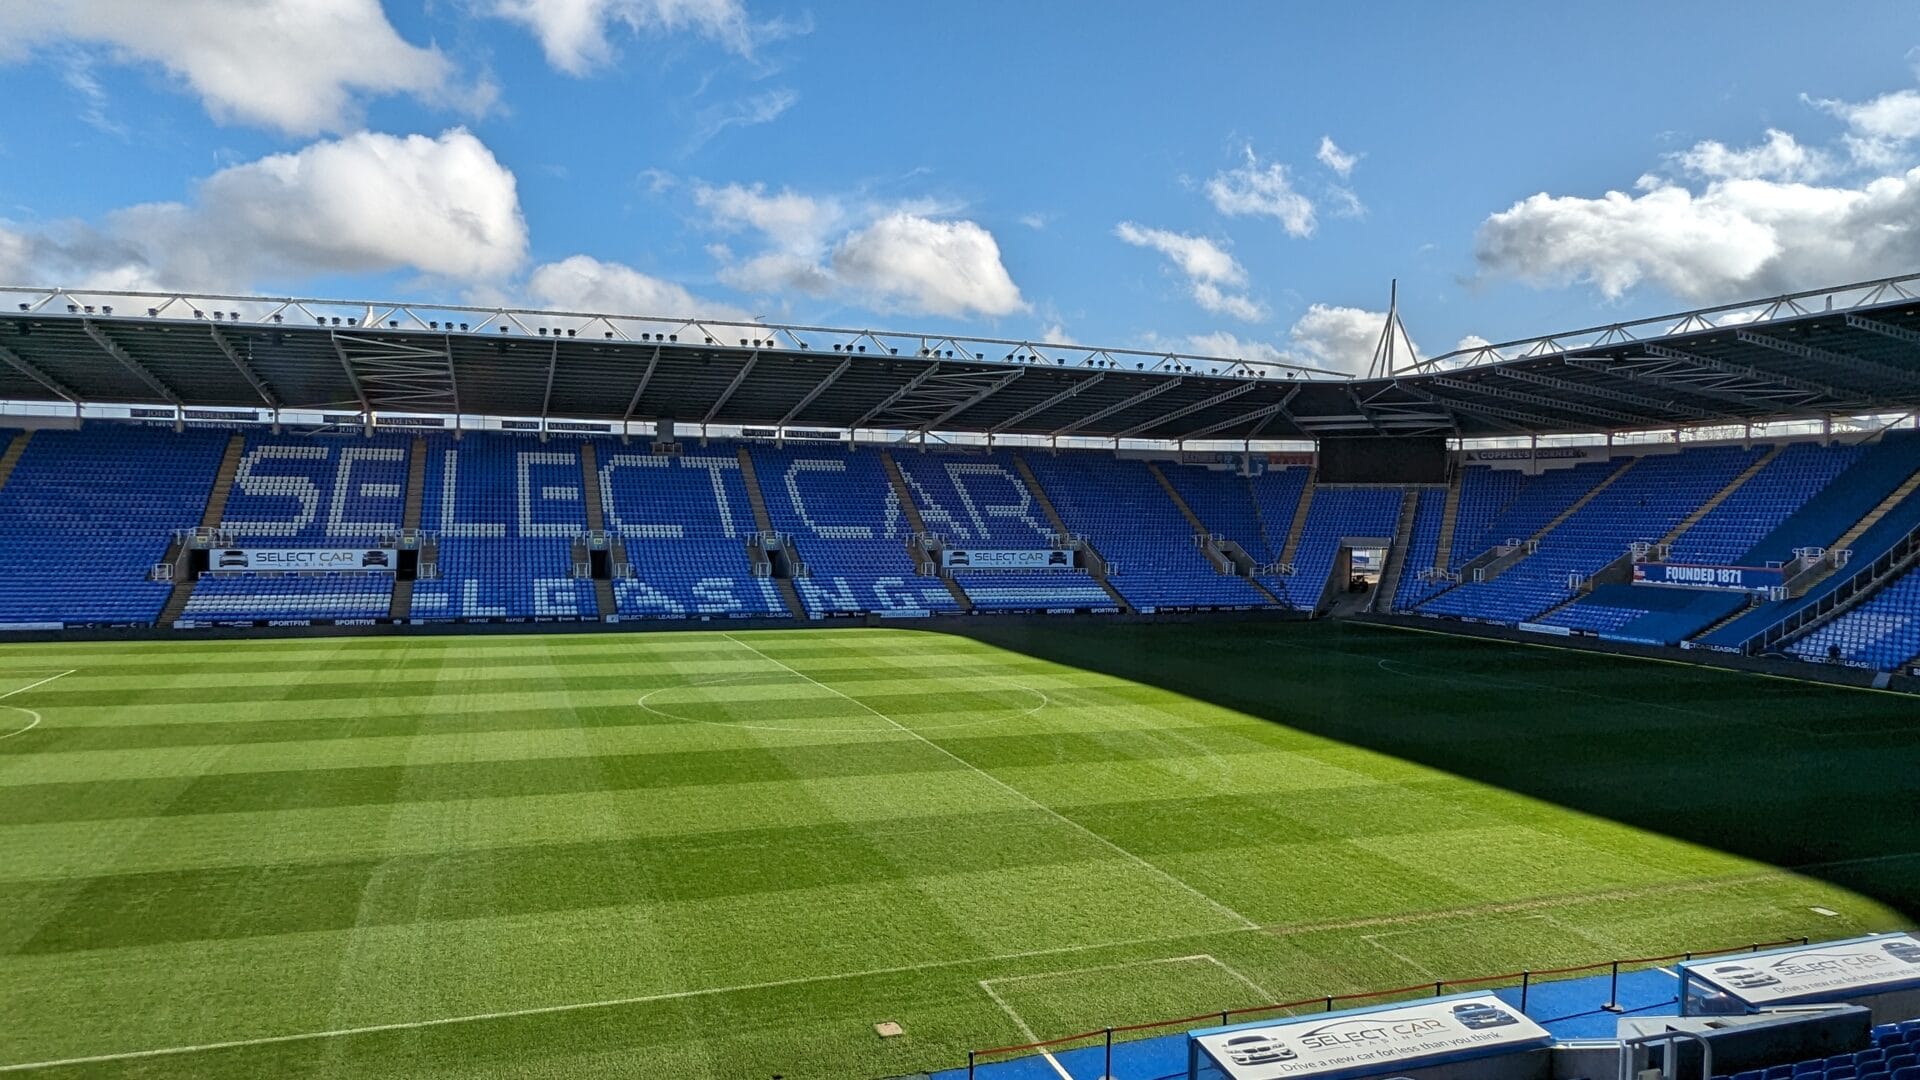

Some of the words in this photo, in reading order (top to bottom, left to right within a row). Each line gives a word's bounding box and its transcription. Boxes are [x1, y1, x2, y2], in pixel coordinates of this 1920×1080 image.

[220, 446, 740, 539] SELECT
[784, 459, 1060, 540] CAR
[256, 552, 315, 562] SELECT
[319, 552, 354, 562] CAR
[974, 552, 1017, 561] SELECT
[1018, 552, 1044, 561] CAR
[1665, 566, 1715, 582] FOUNDED
[1716, 569, 1742, 584] 1871
[461, 577, 921, 616] LEASING
[268, 619, 310, 627] SPORTFIVE
[335, 618, 376, 626] SPORTFIVE
[1774, 960, 1843, 976] SELECT
[1841, 954, 1887, 966] CAR
[1302, 1028, 1388, 1049] SELECT
[1392, 1019, 1446, 1035] CAR
[1343, 1032, 1423, 1049] LEASING
[1280, 1060, 1318, 1072] Drive
[1328, 1055, 1355, 1065] new
[1357, 1052, 1375, 1061] car
[1375, 1047, 1396, 1058] for
[1395, 1044, 1420, 1054] less
[1419, 1039, 1449, 1050] than
[1448, 1036, 1471, 1048] you
